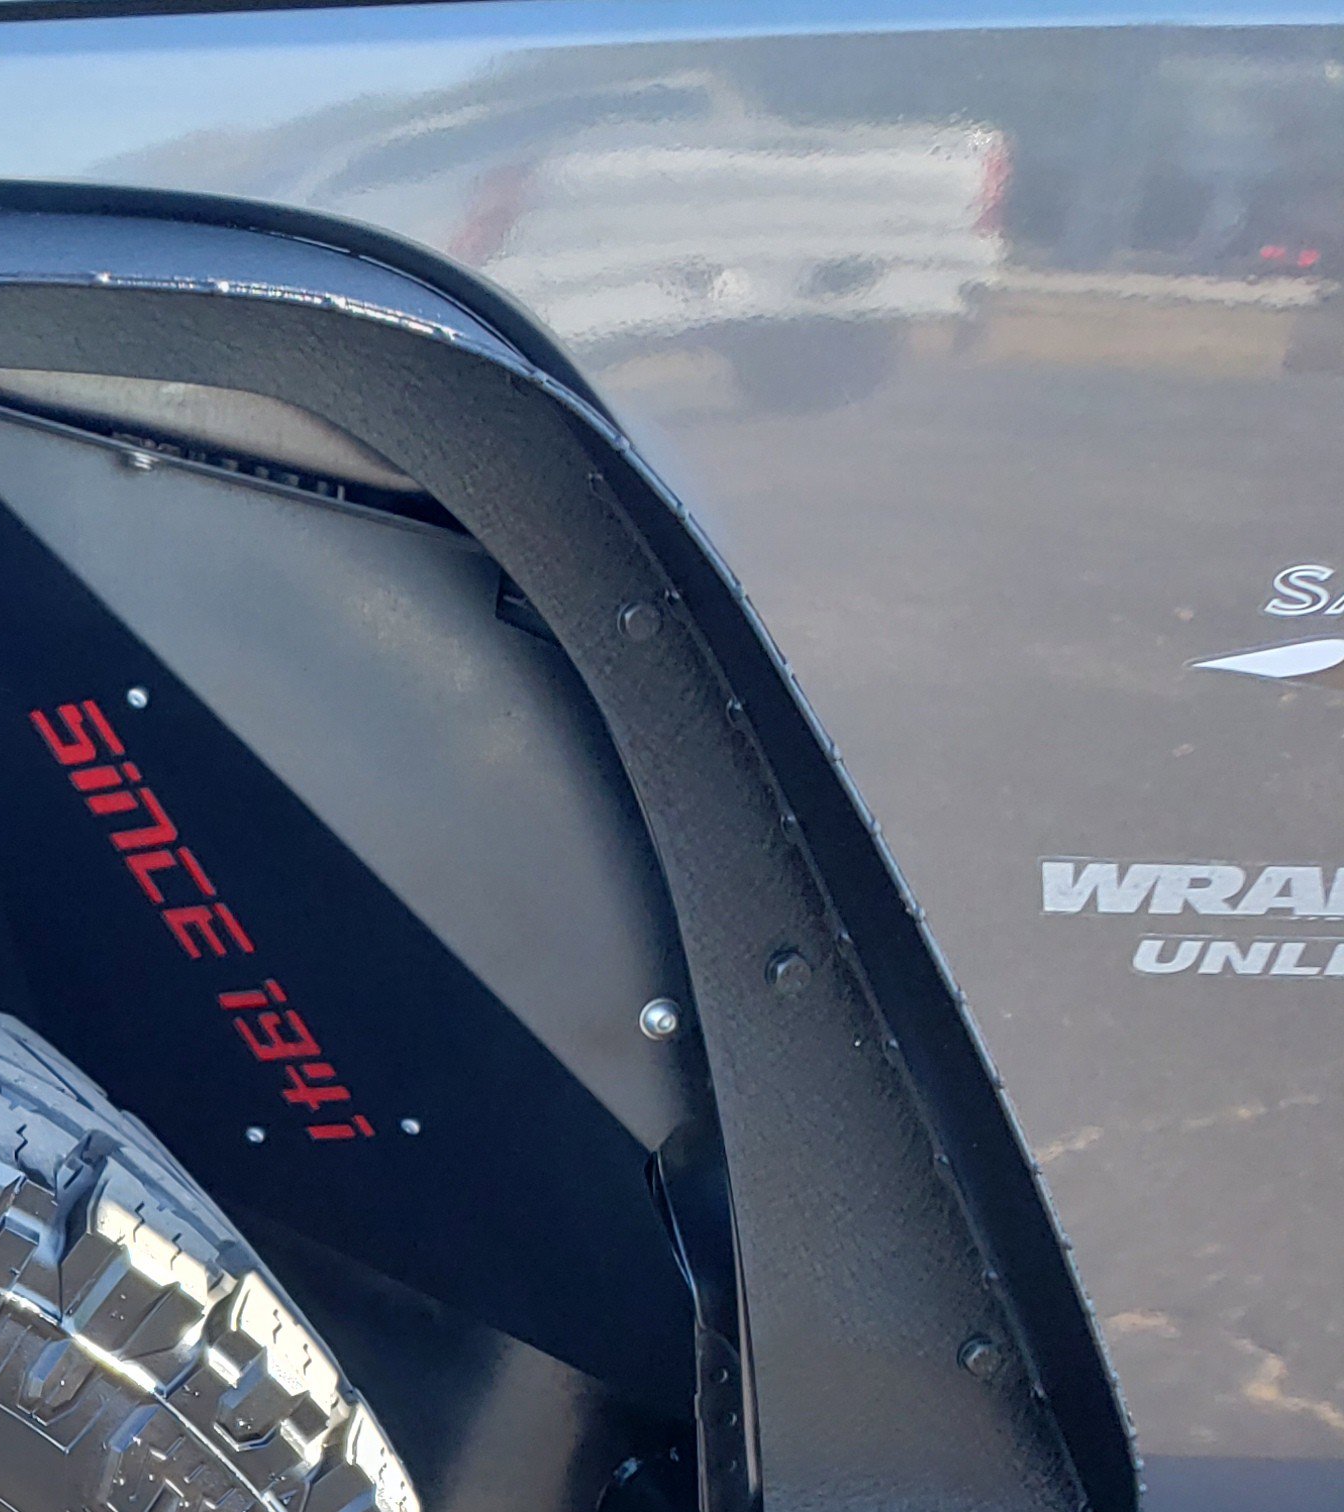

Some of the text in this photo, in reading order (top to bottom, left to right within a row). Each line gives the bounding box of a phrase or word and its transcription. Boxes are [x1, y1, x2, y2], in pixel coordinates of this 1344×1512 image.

[1263, 563, 1344, 616] S
[1041, 861, 1344, 916] WRA
[218, 979, 376, 1140] 1941
